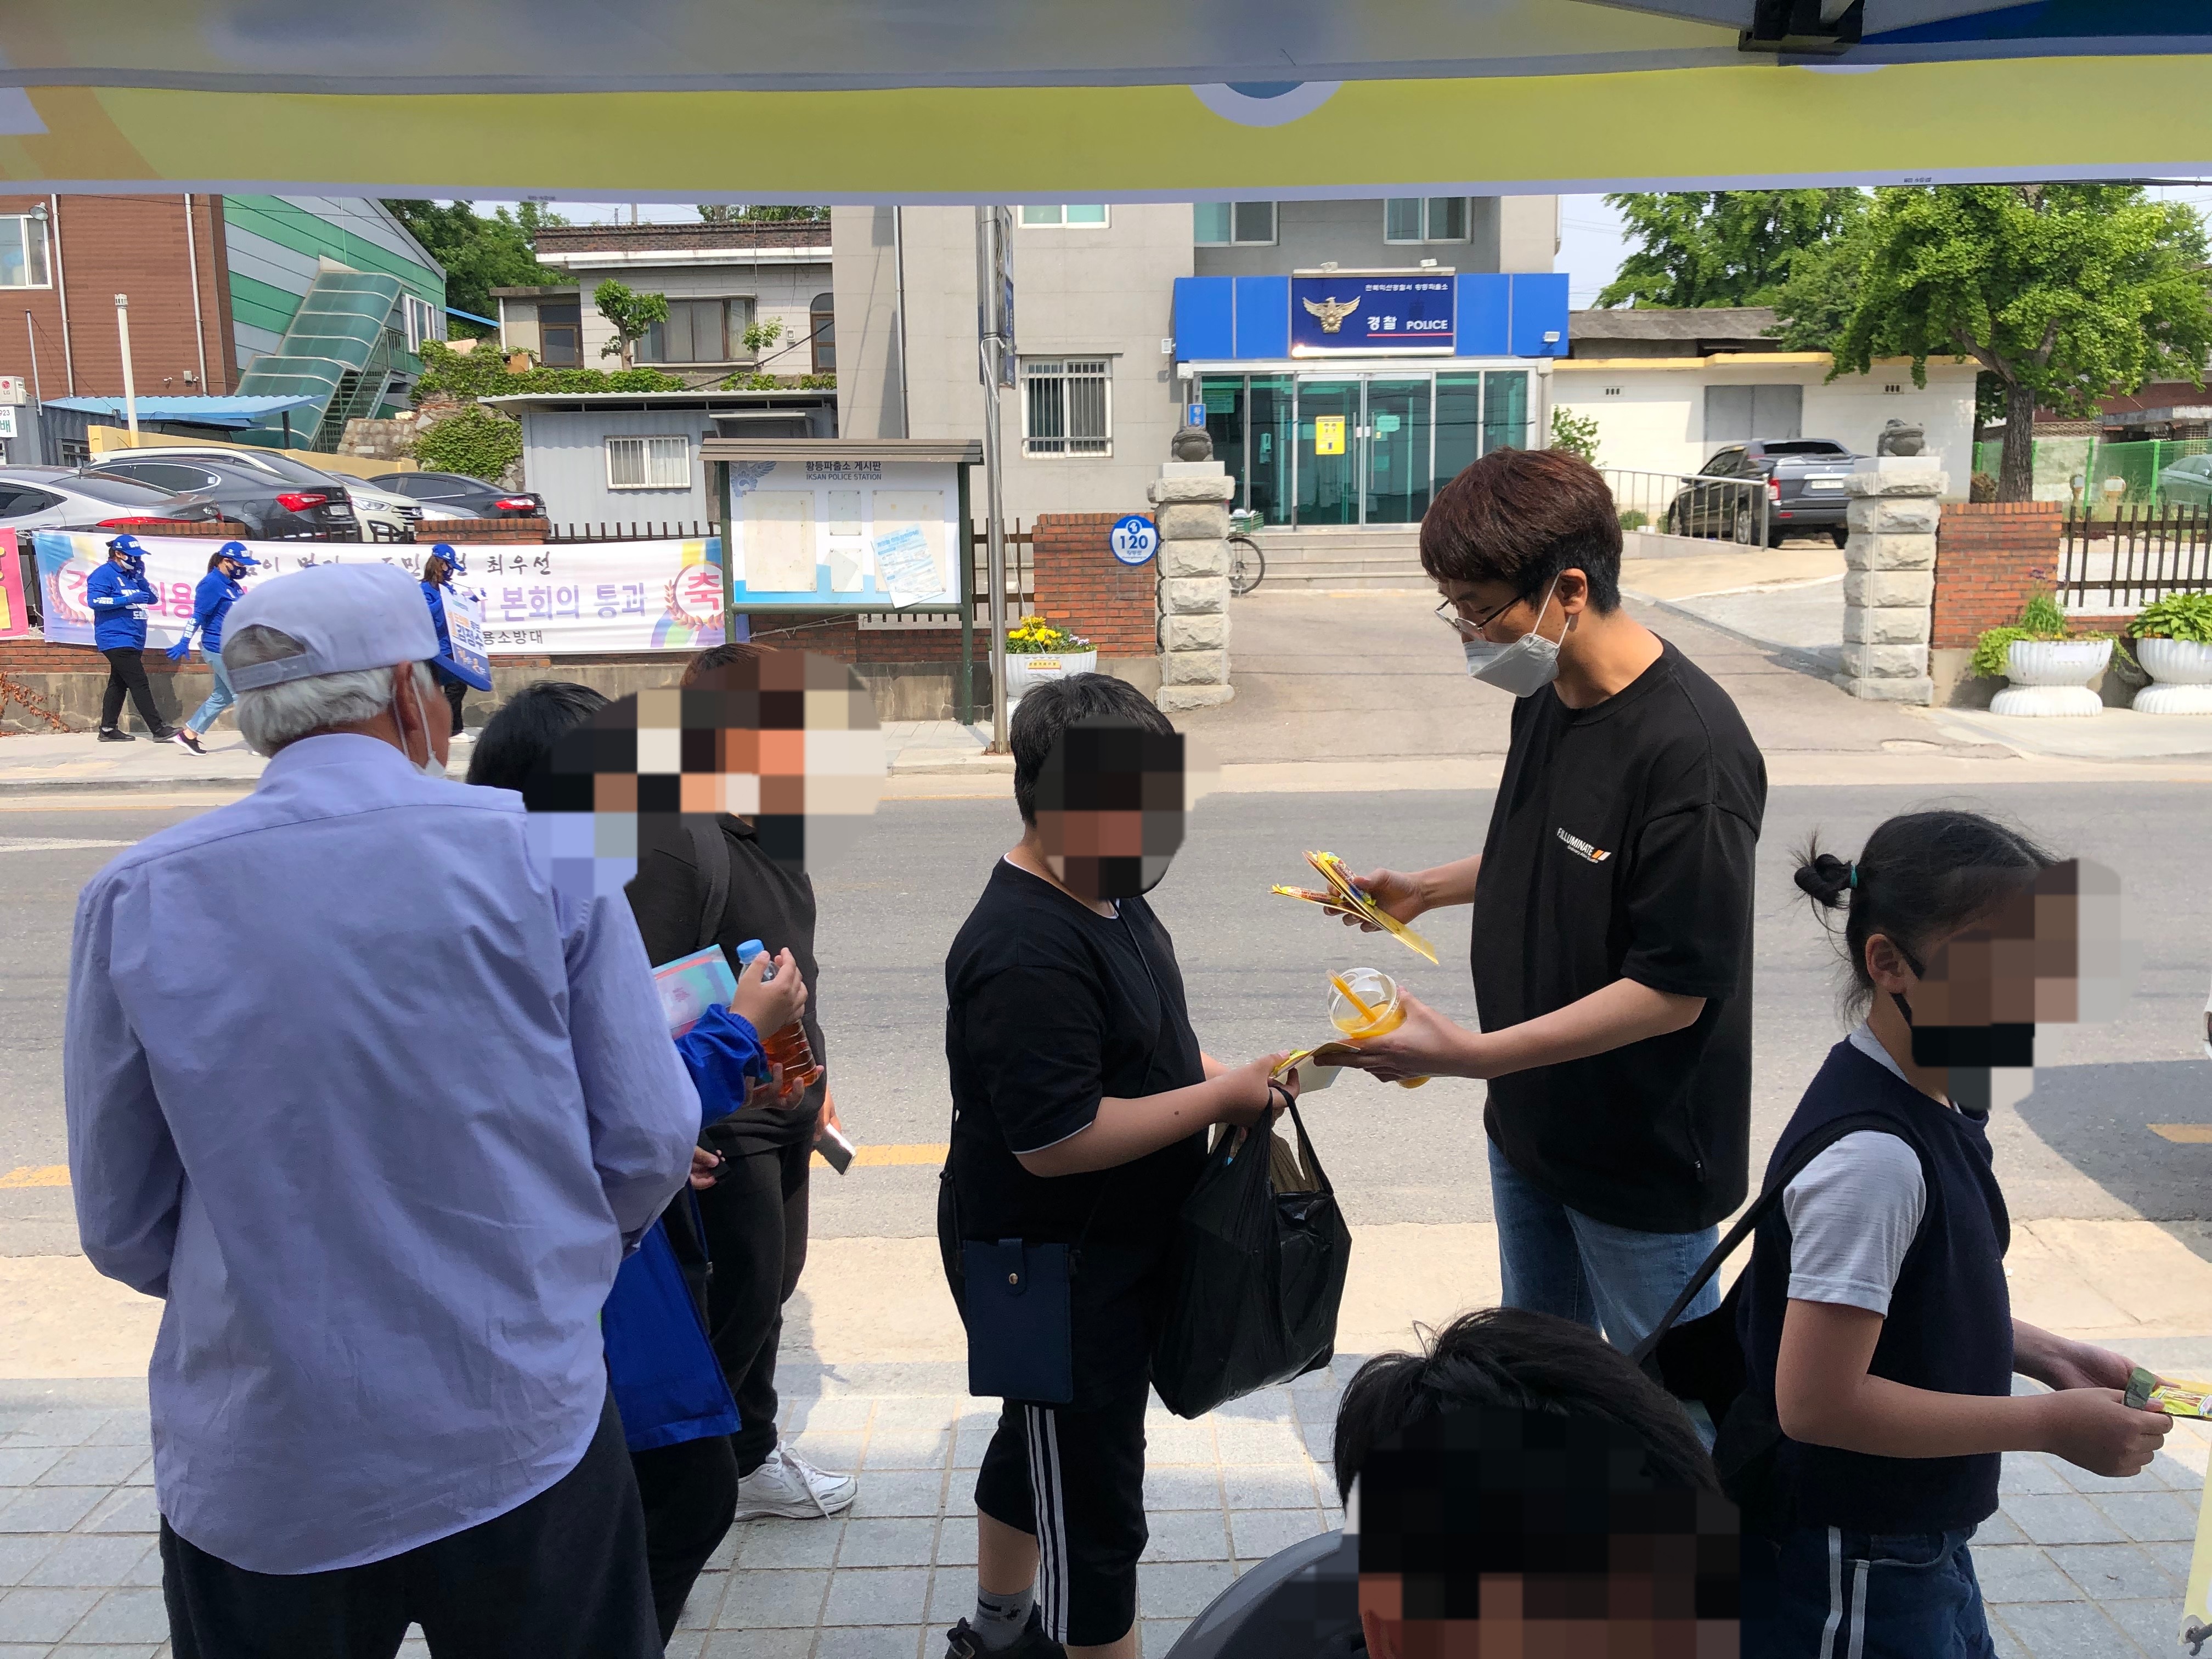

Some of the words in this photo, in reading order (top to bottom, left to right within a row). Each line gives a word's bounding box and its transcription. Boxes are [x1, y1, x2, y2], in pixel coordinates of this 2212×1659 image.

[1367, 315, 1397, 331] 경찰
[1406, 320, 1448, 330] POLICE
[806, 461, 851, 471] 황등파출소
[854, 461, 882, 471] 게시판
[1120, 535, 1148, 549] 120
[487, 551, 552, 575] 최우선
[684, 572, 723, 610] 축
[500, 585, 580, 622] 본회의
[594, 582, 648, 619] 통과
